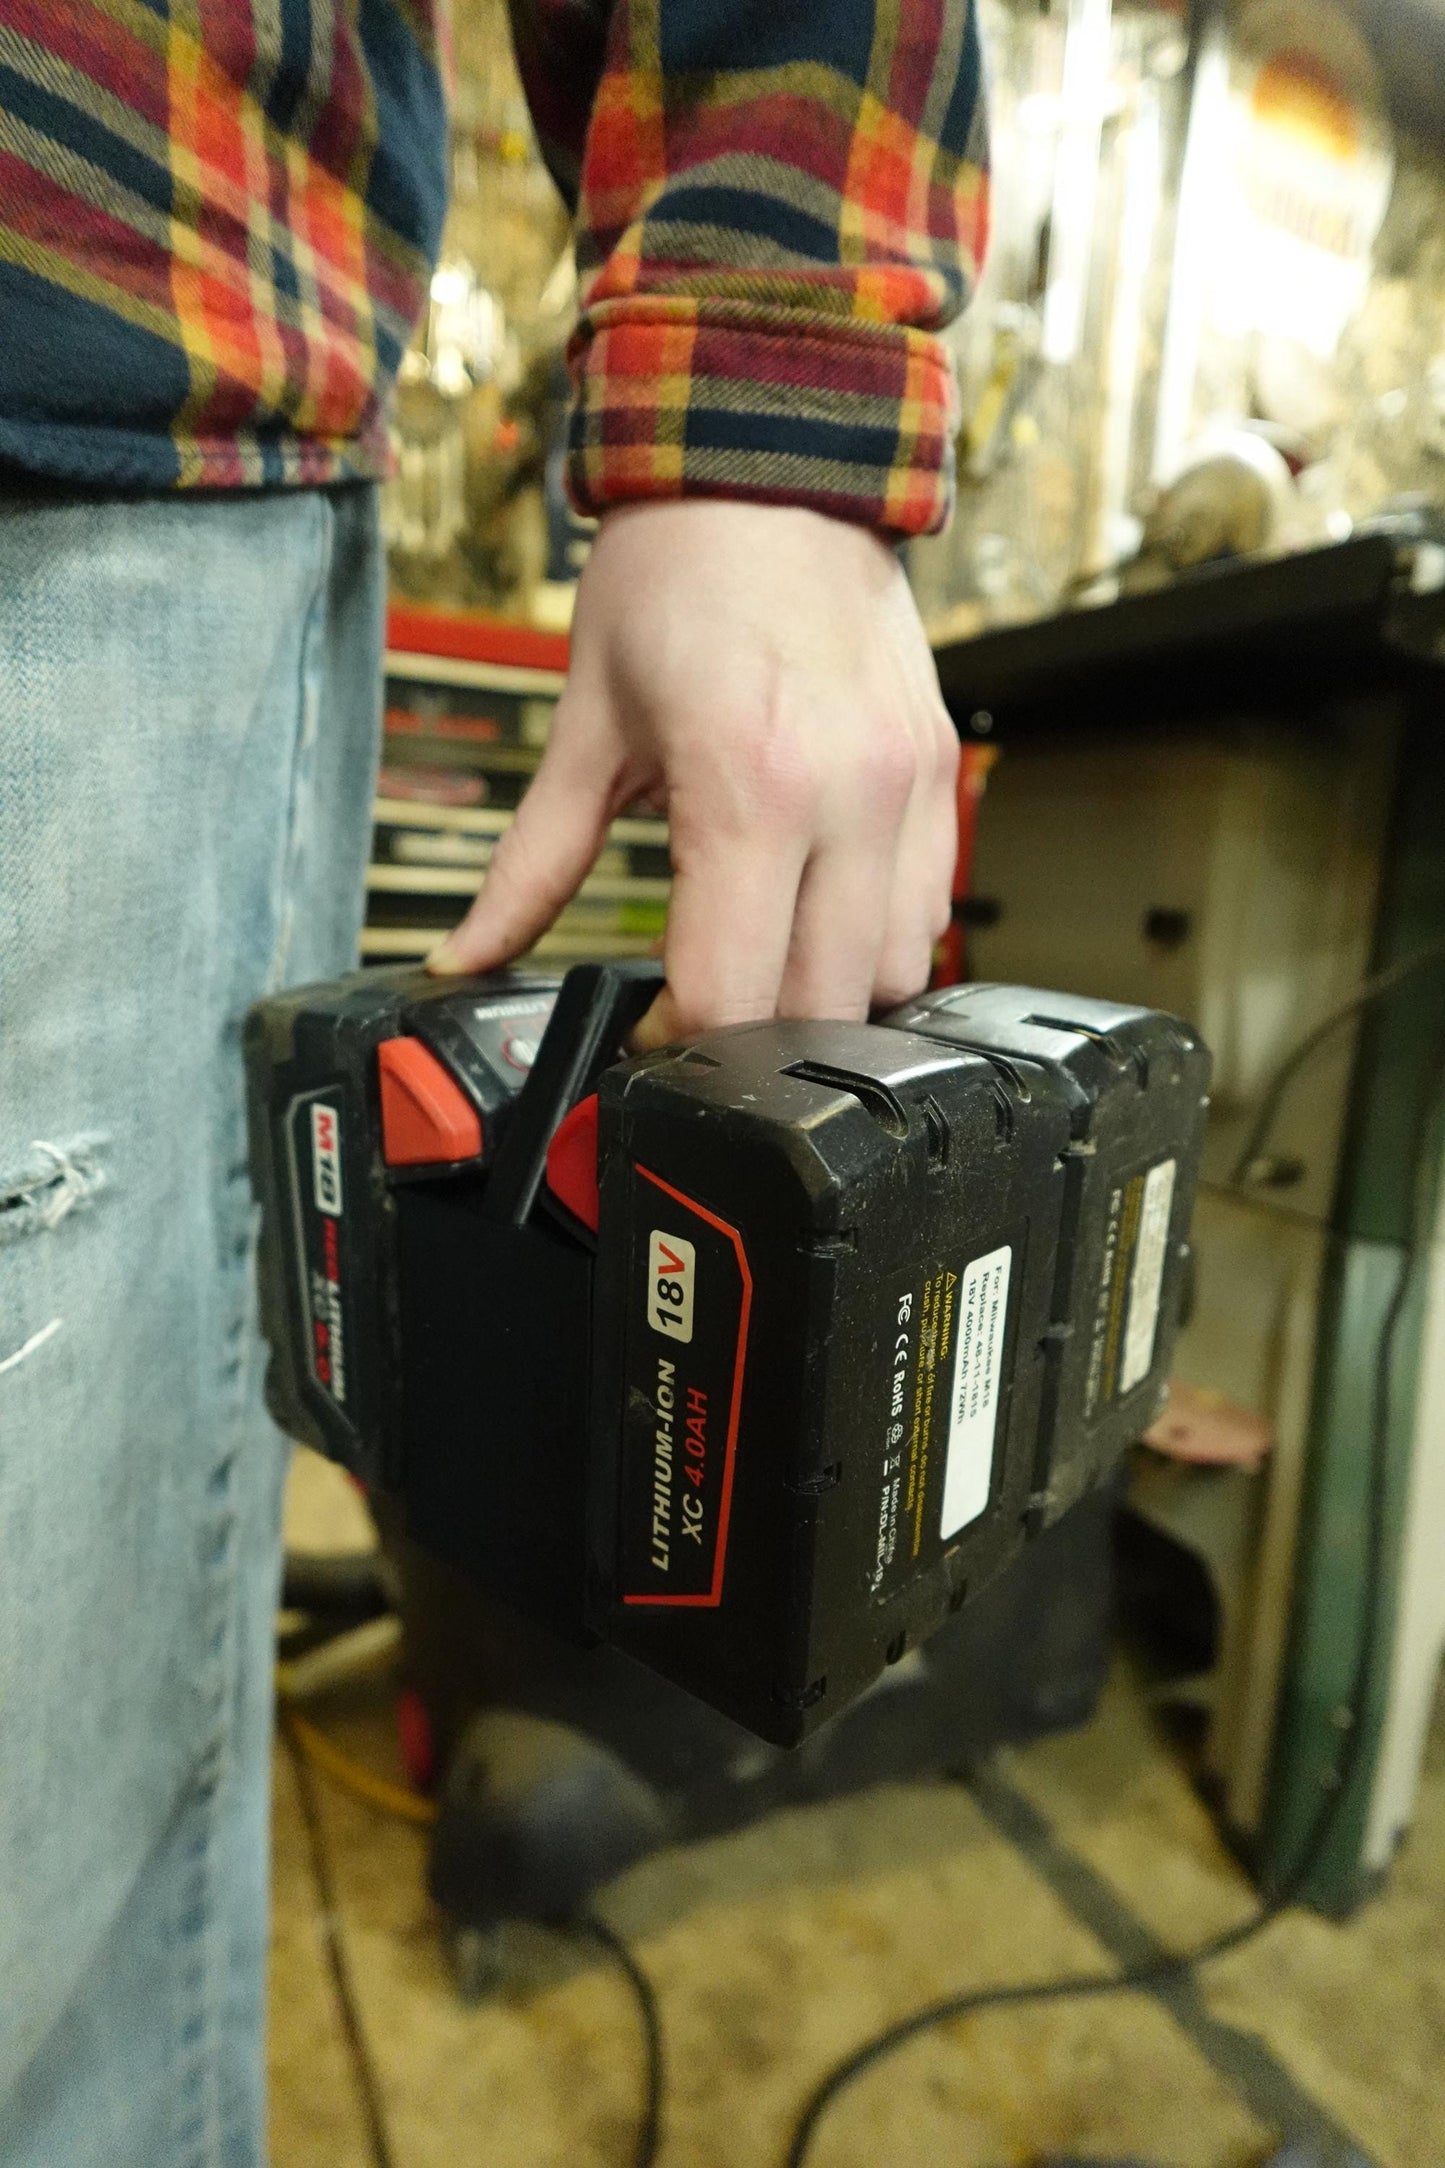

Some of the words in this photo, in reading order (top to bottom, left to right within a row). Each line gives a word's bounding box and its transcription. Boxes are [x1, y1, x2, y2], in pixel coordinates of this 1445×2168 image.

[657, 1241, 686, 1328] 18V
[922, 1279, 933, 1316] crush,
[936, 1274, 943, 1288] To
[968, 1279, 977, 1306] 18V
[932, 1289, 942, 1328] reduce
[977, 1272, 989, 1336] Replace:
[940, 1291, 953, 1361] WARNING:
[962, 1310, 974, 1379] 4000mAh
[986, 1299, 999, 1374] Milwaukee
[891, 1369, 906, 1417] RoHS
[918, 1372, 924, 1384] or
[926, 1384, 934, 1403] fire
[928, 1372, 935, 1384] of
[915, 1386, 924, 1415] short
[925, 1405, 931, 1417] or
[958, 1383, 967, 1424] 72Wh
[686, 1387, 708, 1487] 4.0AH
[652, 1358, 676, 1571] LITHIUM-ION
[891, 1477, 901, 1513] Made
[681, 1493, 703, 1545] XC
[890, 1513, 898, 1526] in
